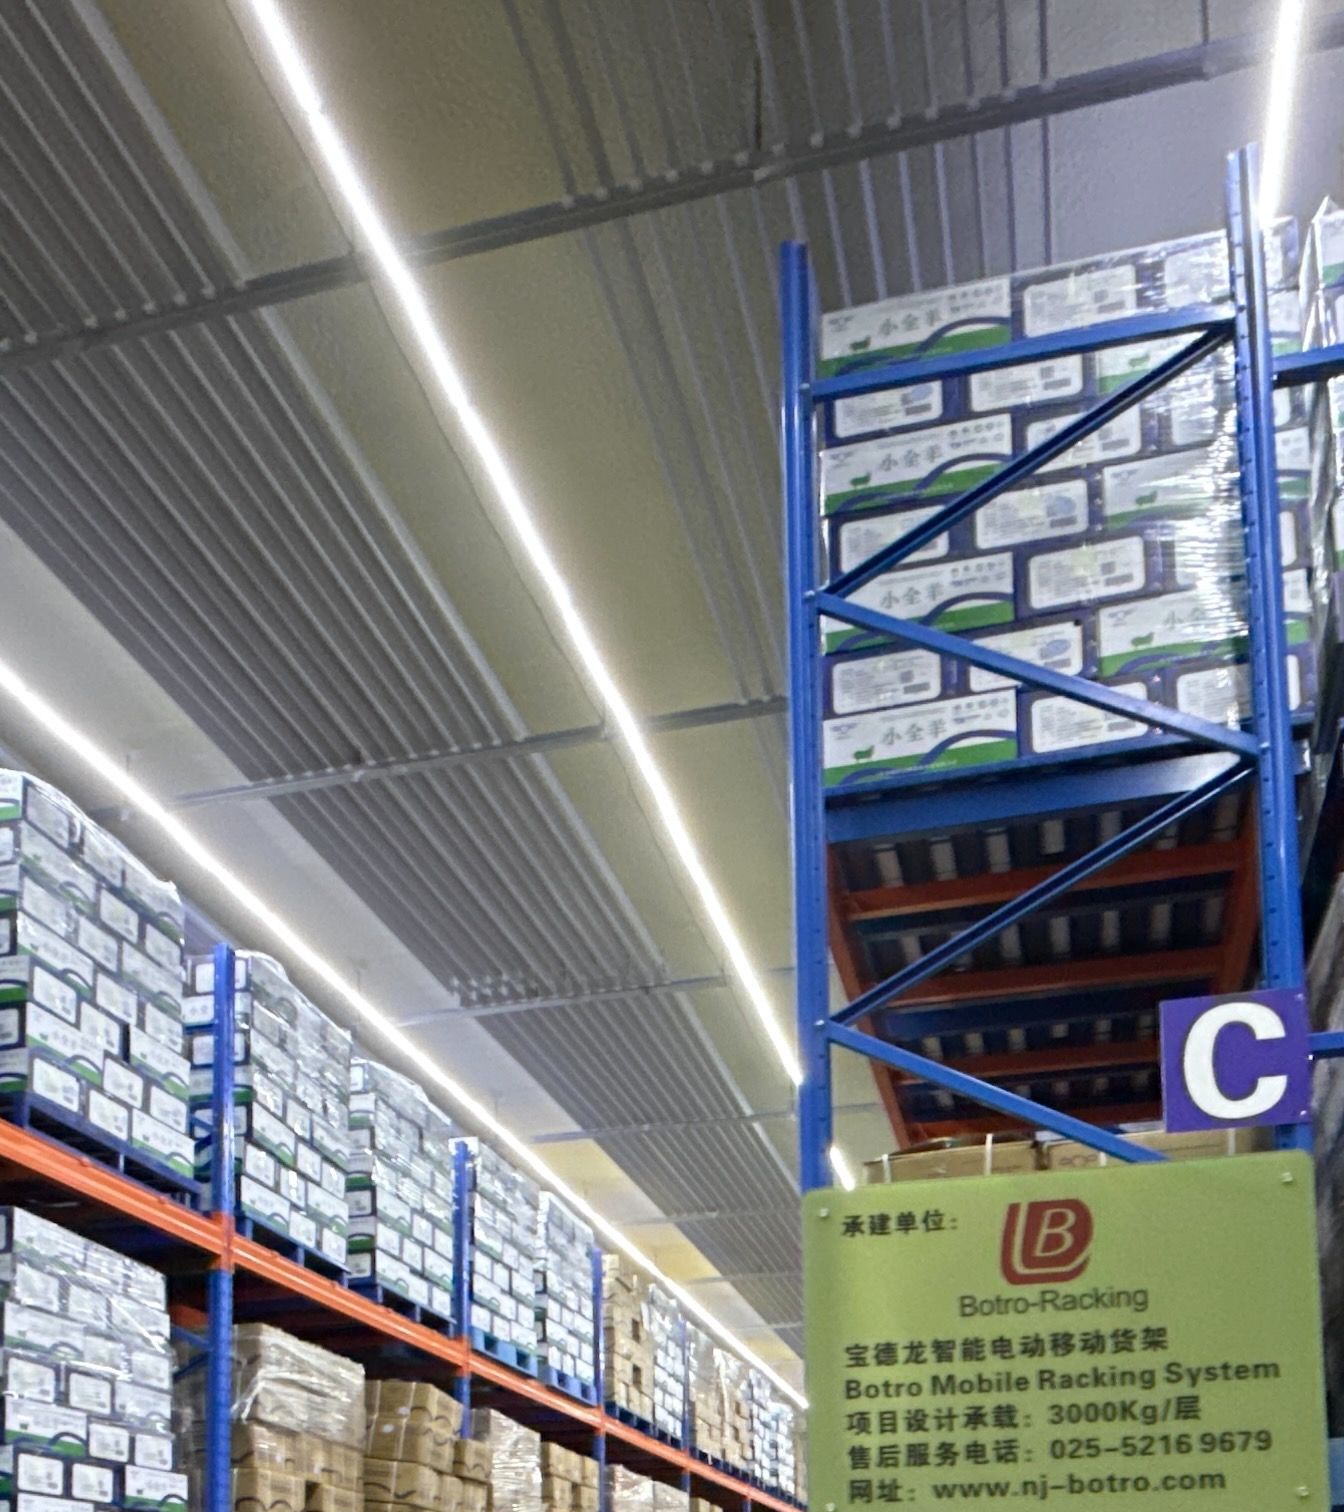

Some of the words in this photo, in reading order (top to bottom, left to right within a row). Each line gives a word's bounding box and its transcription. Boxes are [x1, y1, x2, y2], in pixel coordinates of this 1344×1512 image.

[1183, 1001, 1288, 1121] C
[959, 1287, 1150, 1319] Botro-Racking
[845, 1326, 1169, 1369] 宝德龙智能电动移动货架
[845, 1378, 924, 1401] Botro
[931, 1370, 1031, 1396] Mobile
[1038, 1364, 1156, 1391] Racking
[1164, 1360, 1282, 1388] System
